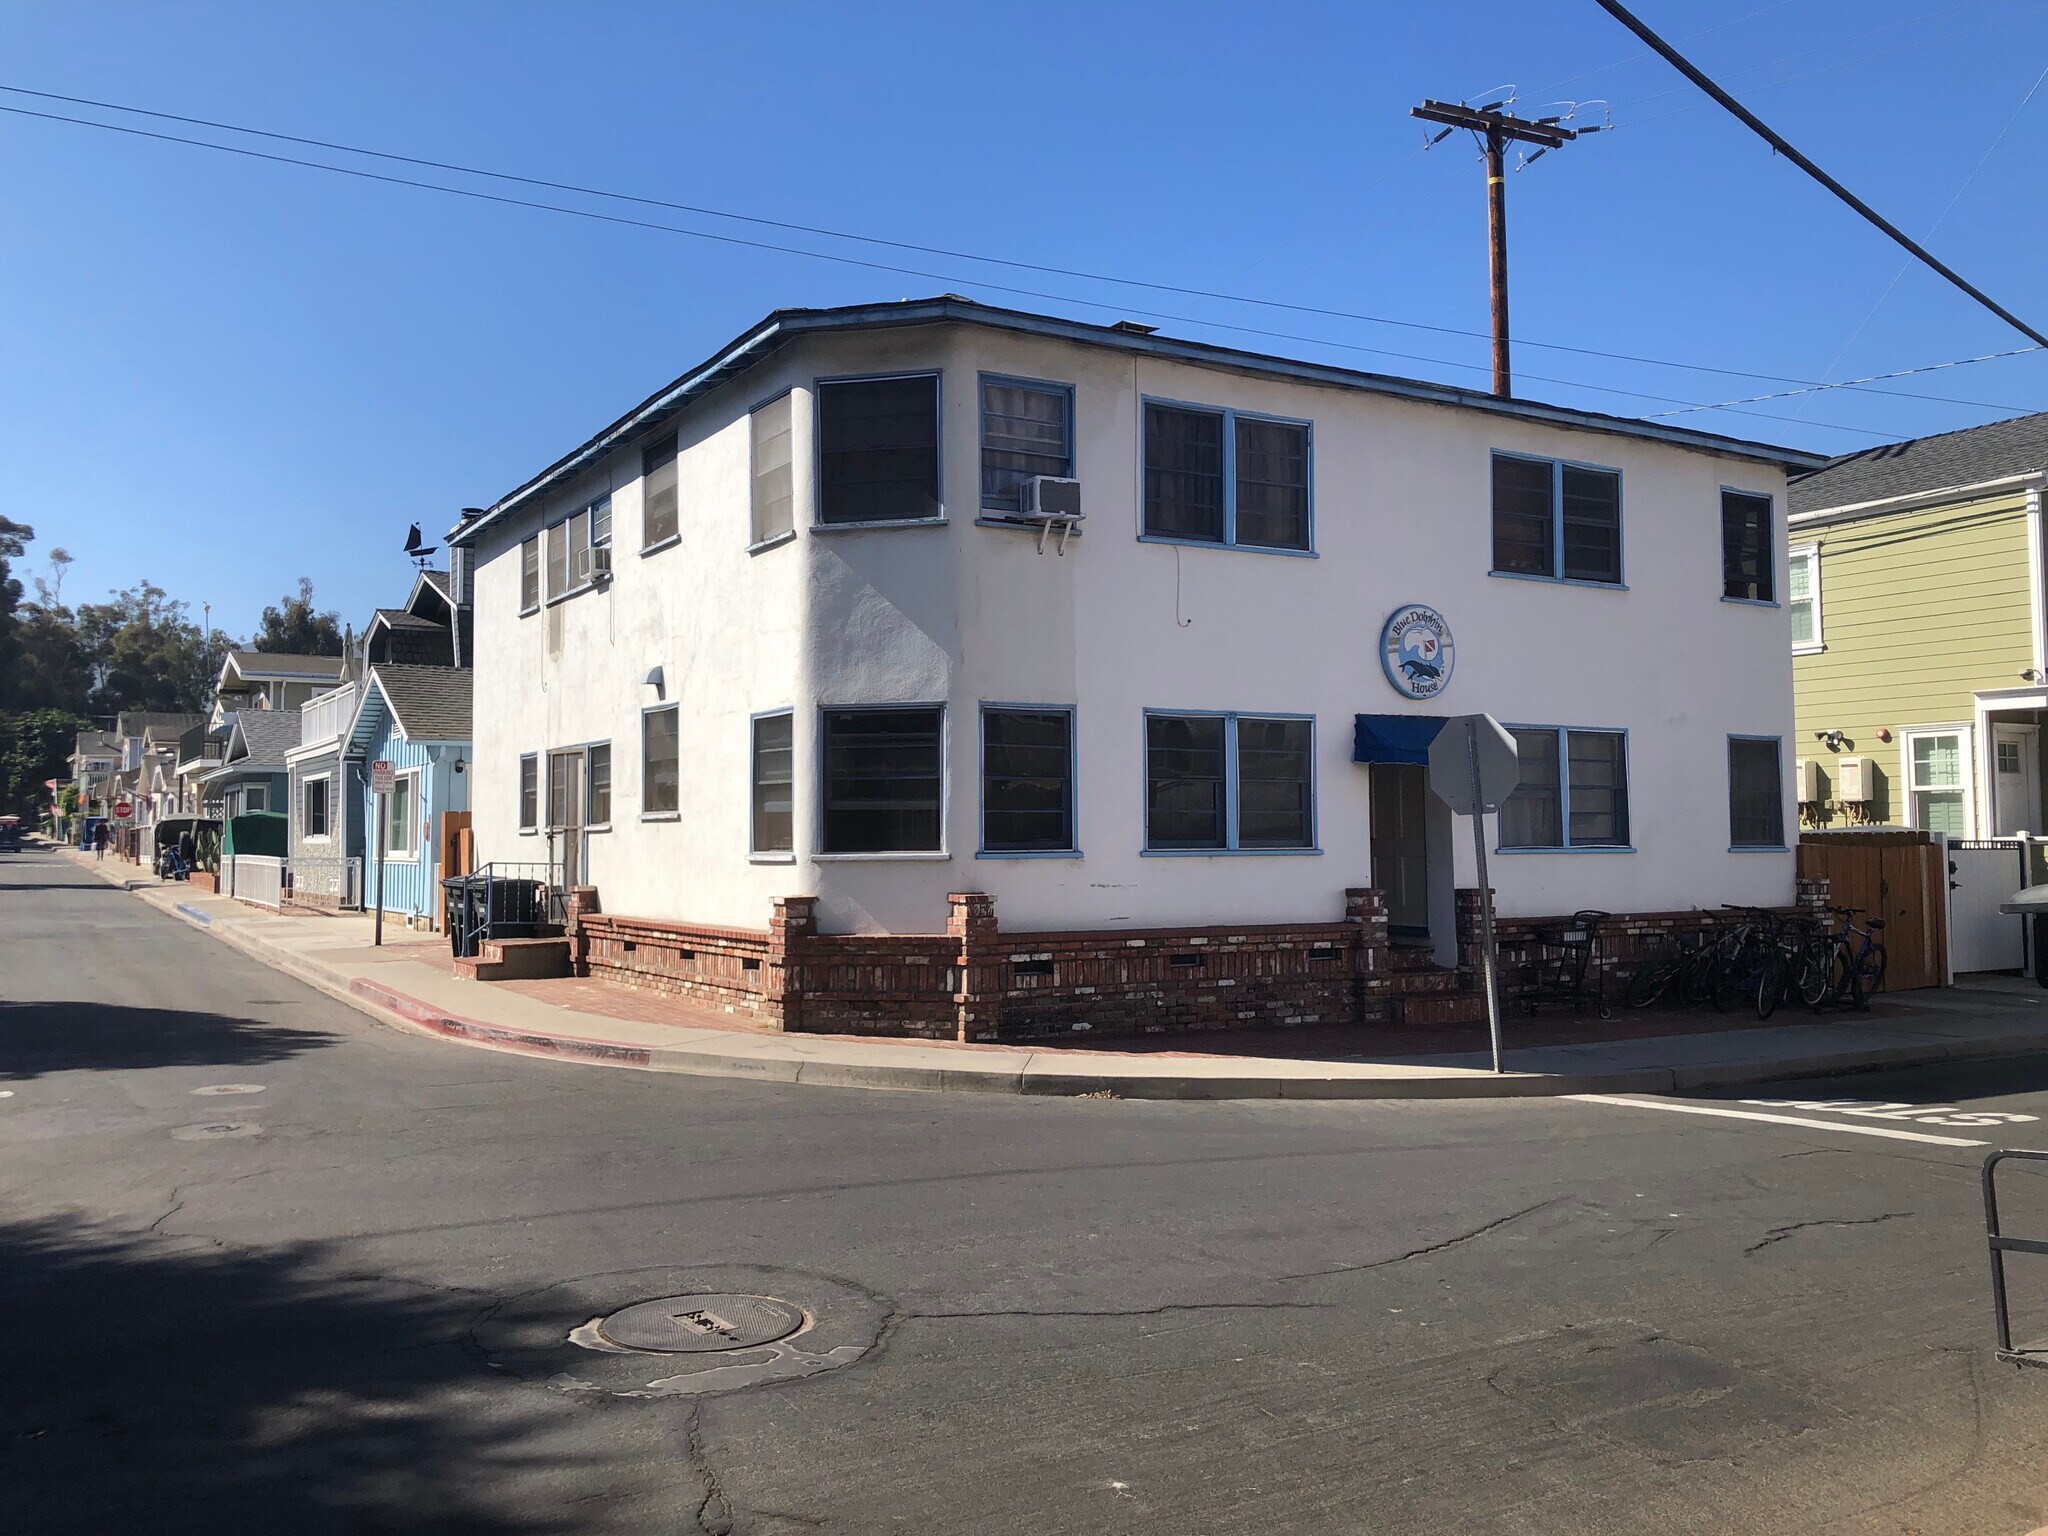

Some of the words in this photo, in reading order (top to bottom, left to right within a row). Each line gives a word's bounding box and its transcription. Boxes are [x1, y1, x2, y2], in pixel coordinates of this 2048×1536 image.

[1392, 616, 1410, 636] Blue
[1409, 611, 1443, 632] Dolphin
[1411, 682, 1439, 693] House
[115, 806, 131, 814] STOP
